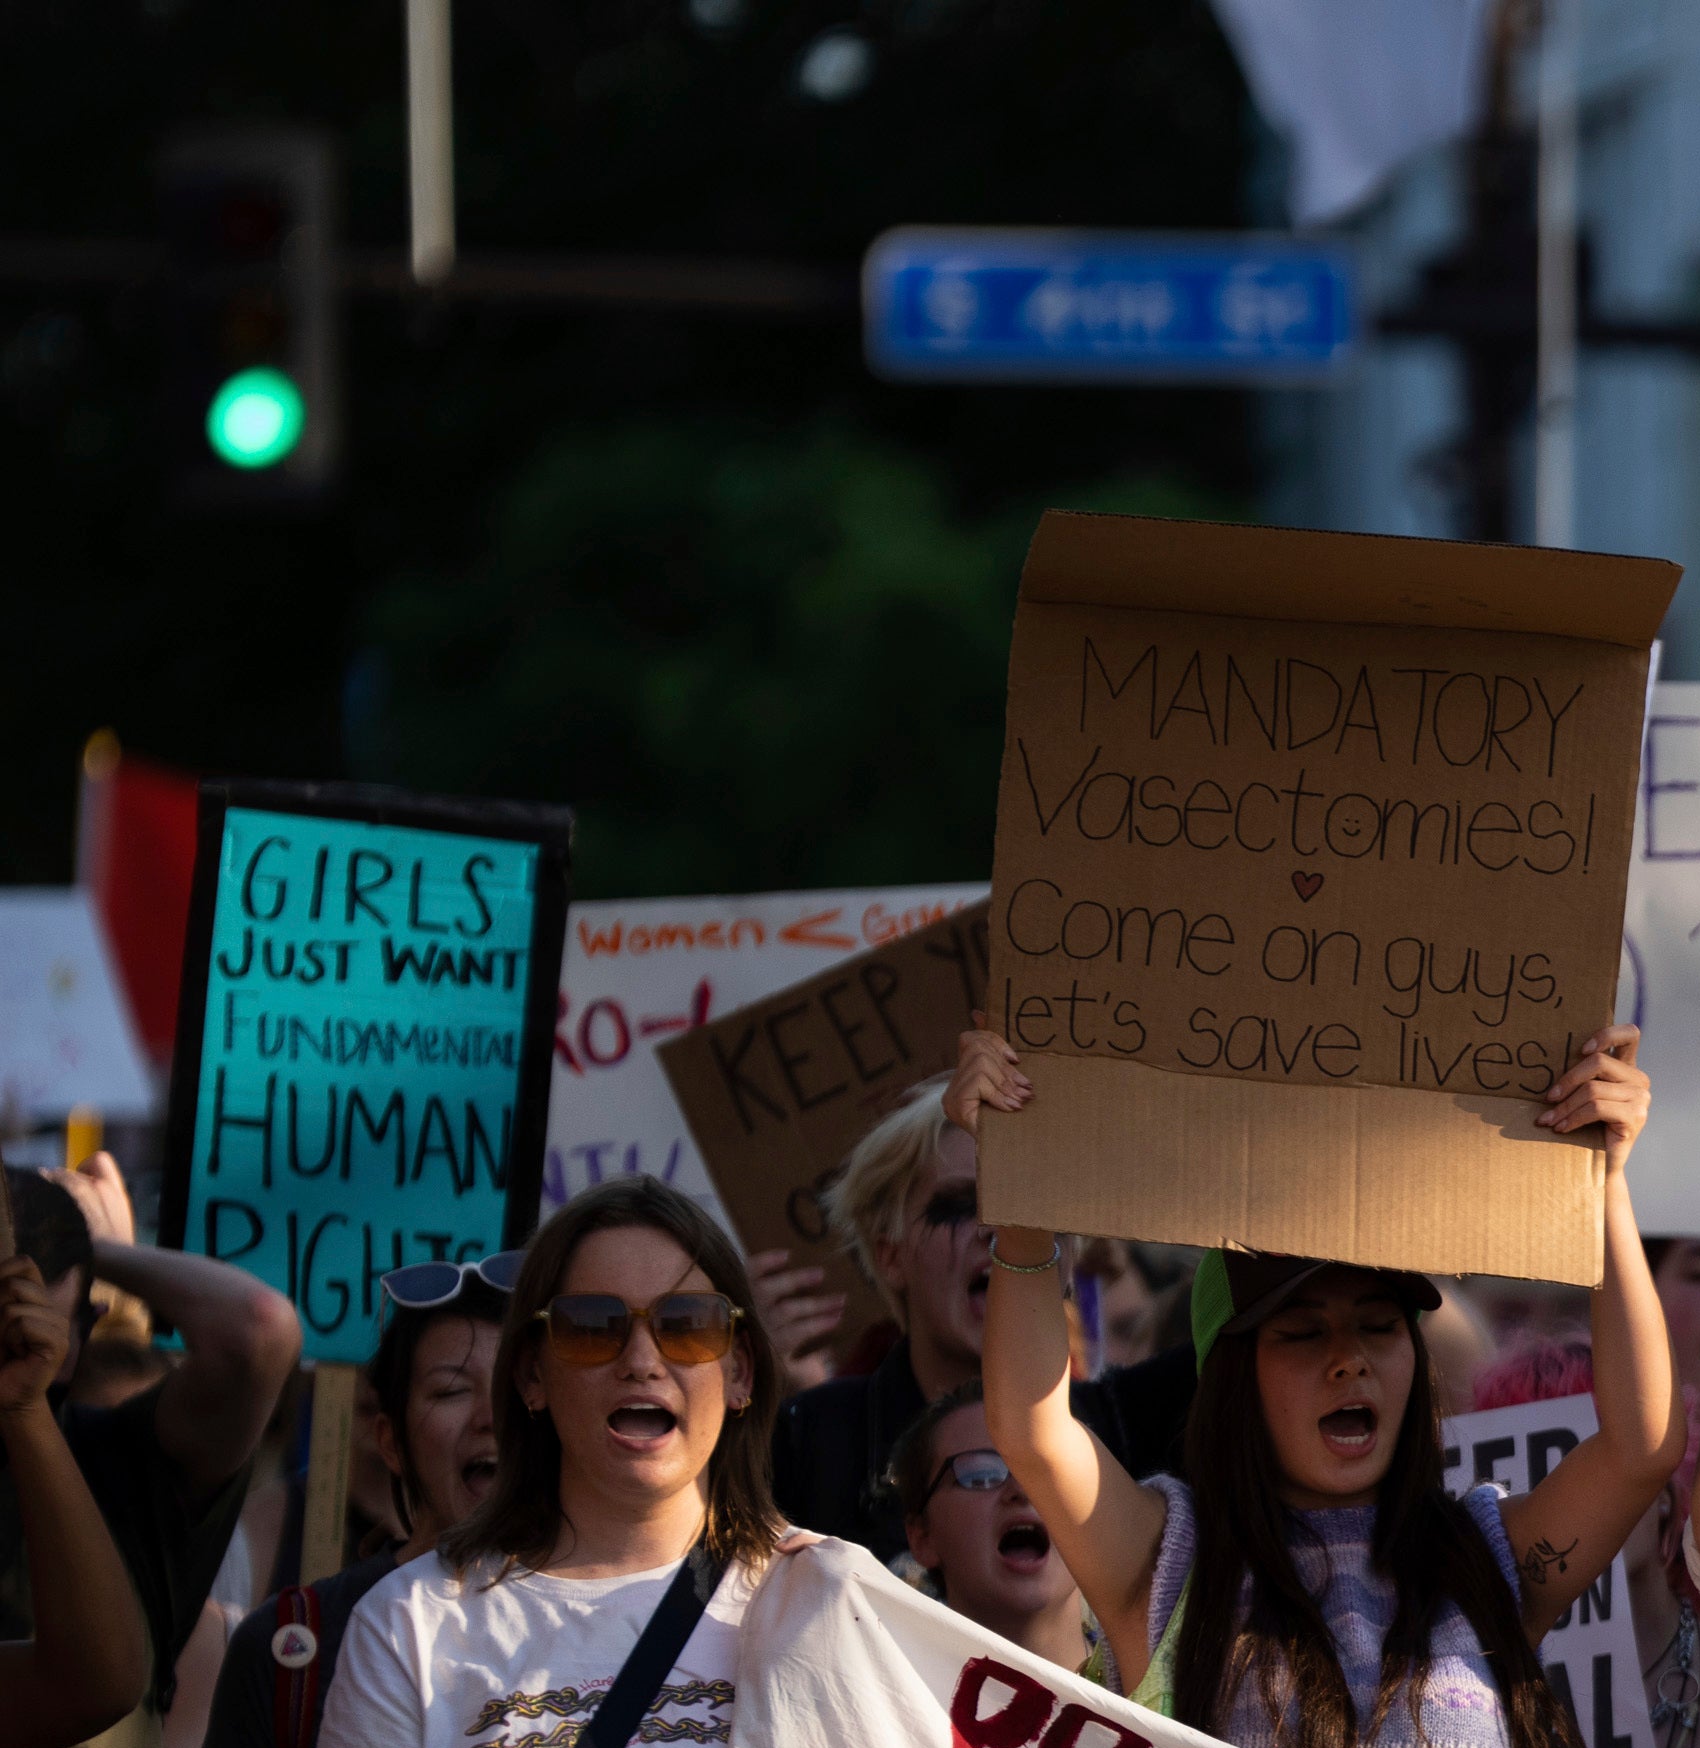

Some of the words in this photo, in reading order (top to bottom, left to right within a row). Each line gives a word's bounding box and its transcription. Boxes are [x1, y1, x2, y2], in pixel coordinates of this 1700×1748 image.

[1080, 636, 1585, 778] MANDATORY
[1017, 737, 1596, 876] Vasectomies!
[240, 834, 495, 937] GIRLS
[577, 915, 767, 959] Women
[216, 926, 360, 984] JUST
[380, 937, 527, 991] WANT
[1005, 878, 1235, 977] Come
[1262, 926, 1361, 987] on
[1382, 936, 1564, 1027] guys,
[709, 962, 912, 1136] KEEP
[1004, 978, 1147, 1055] let's
[1177, 1007, 1361, 1078] save
[206, 1064, 513, 1196] HUMAN
